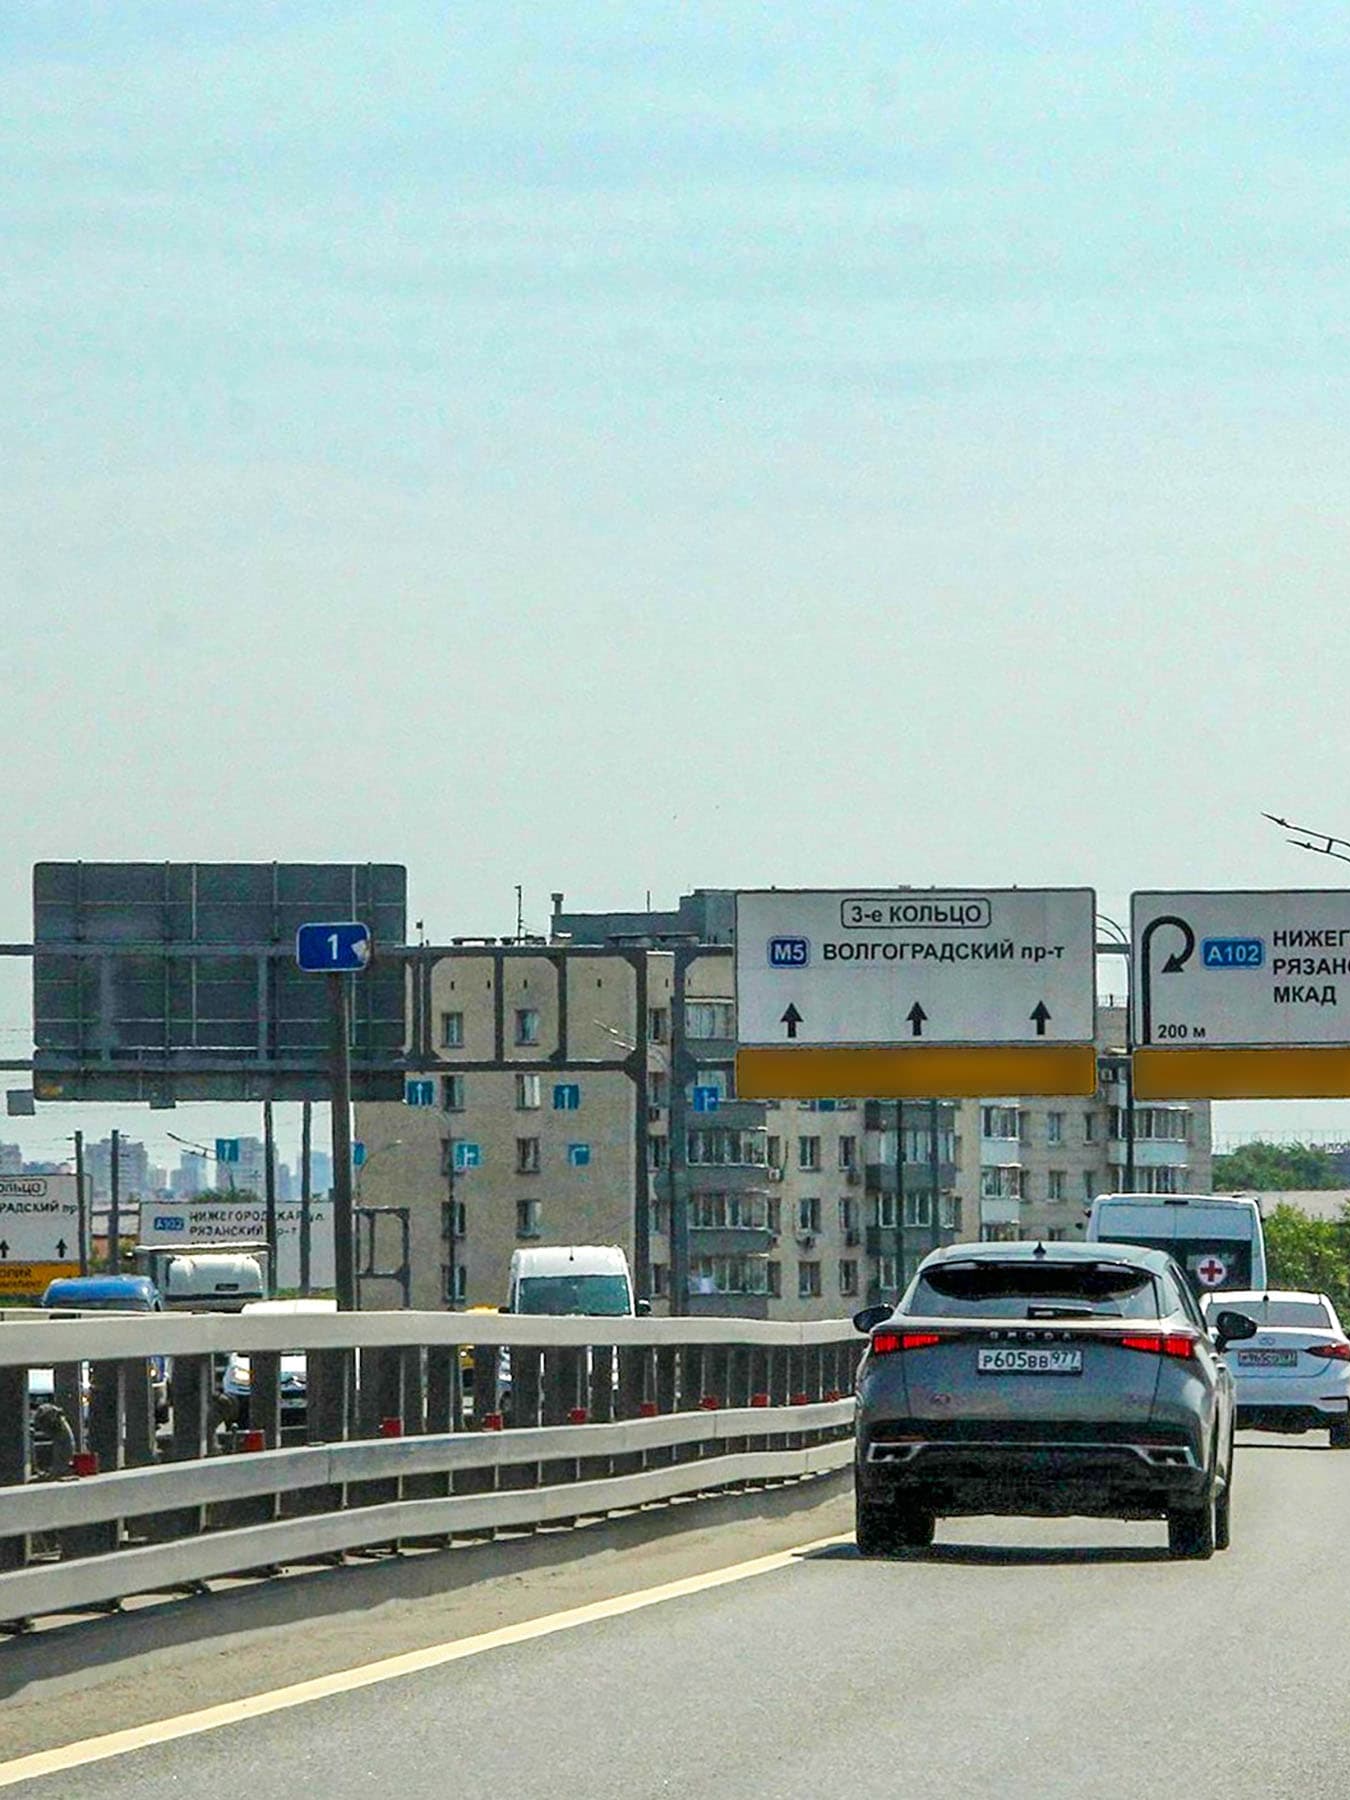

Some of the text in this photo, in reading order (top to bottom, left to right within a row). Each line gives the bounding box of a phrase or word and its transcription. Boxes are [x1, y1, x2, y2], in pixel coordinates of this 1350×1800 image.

[851, 904, 982, 926] 3-е КОЛЬЦО
[327, 933, 339, 960] 1
[823, 939, 1065, 963] ВОЛГОГРАДСКИЙ пр-т
[1273, 985, 1337, 1006] МКАД
[1157, 1023, 1206, 1039] 200 м
